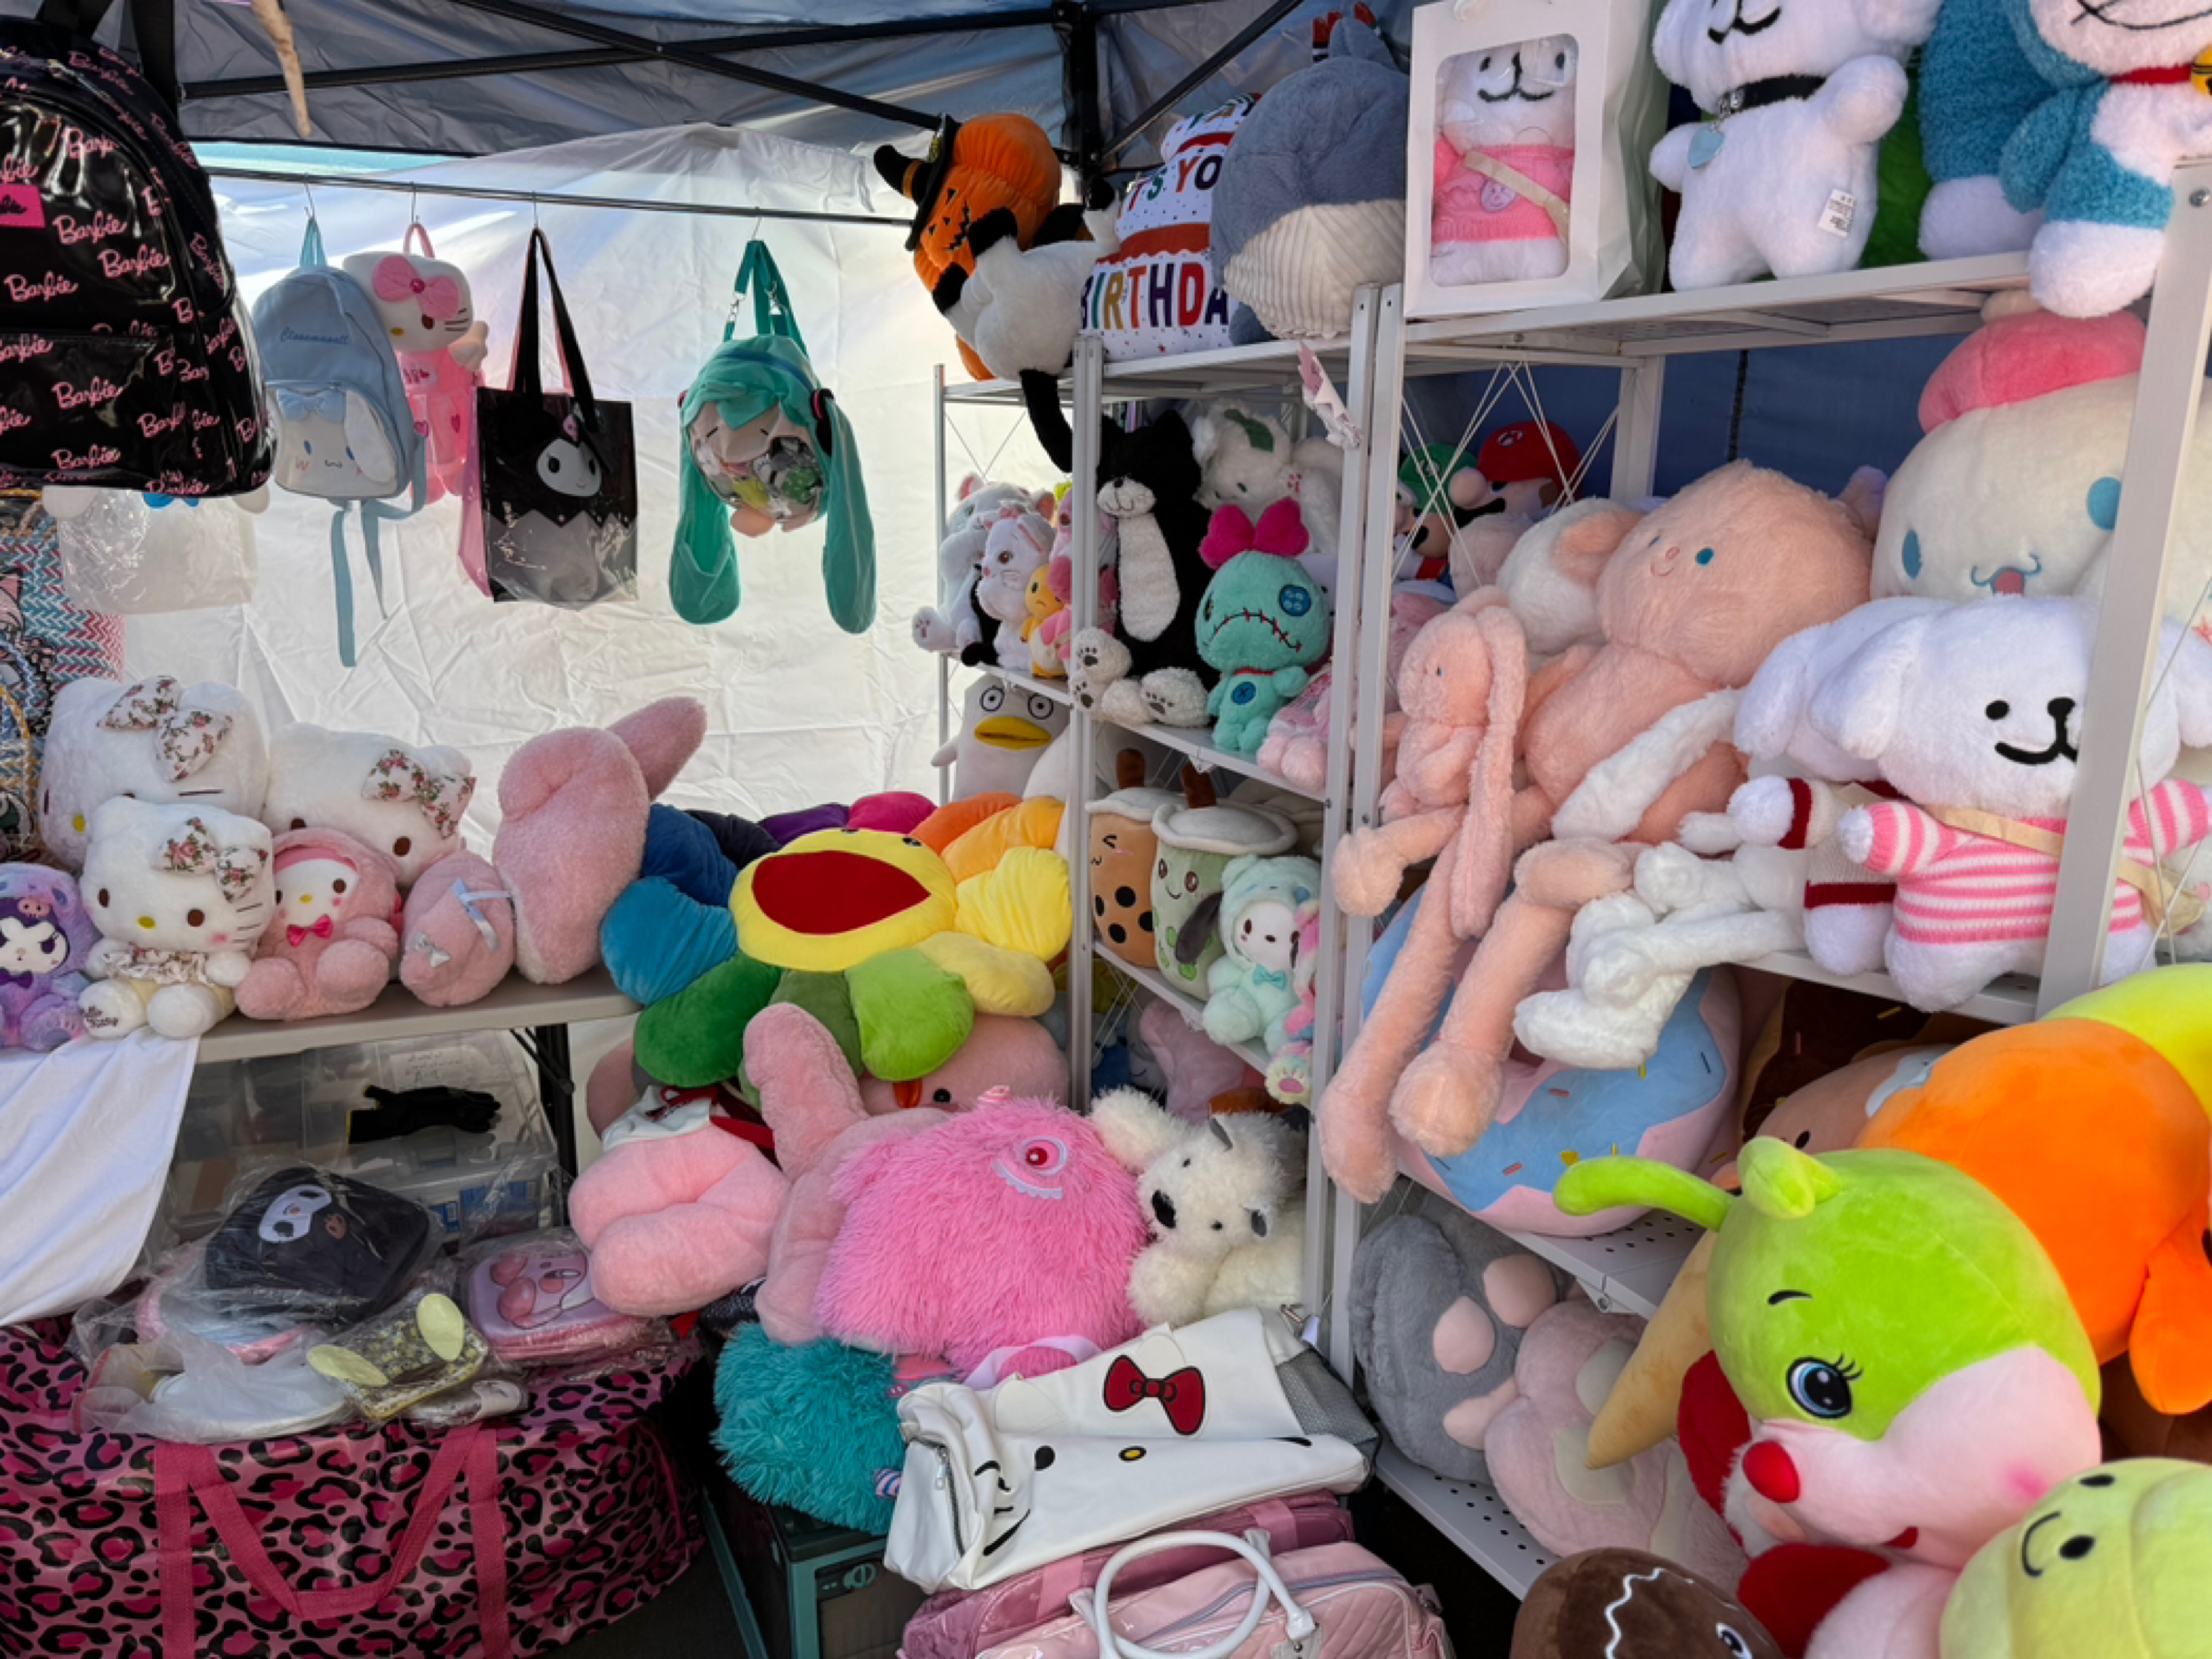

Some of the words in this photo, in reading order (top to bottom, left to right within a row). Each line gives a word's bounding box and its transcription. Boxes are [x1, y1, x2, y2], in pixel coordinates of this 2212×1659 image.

[1176, 156, 1223, 193] YO
[53, 210, 127, 245] Barbie
[97, 244, 171, 278] Barbie
[4, 270, 78, 302] Barbie
[1082, 261, 1229, 330] IRTHDA
[0, 333, 55, 361] arbie
[51, 376, 123, 409] Barbie
[51, 444, 121, 469] Barbie
